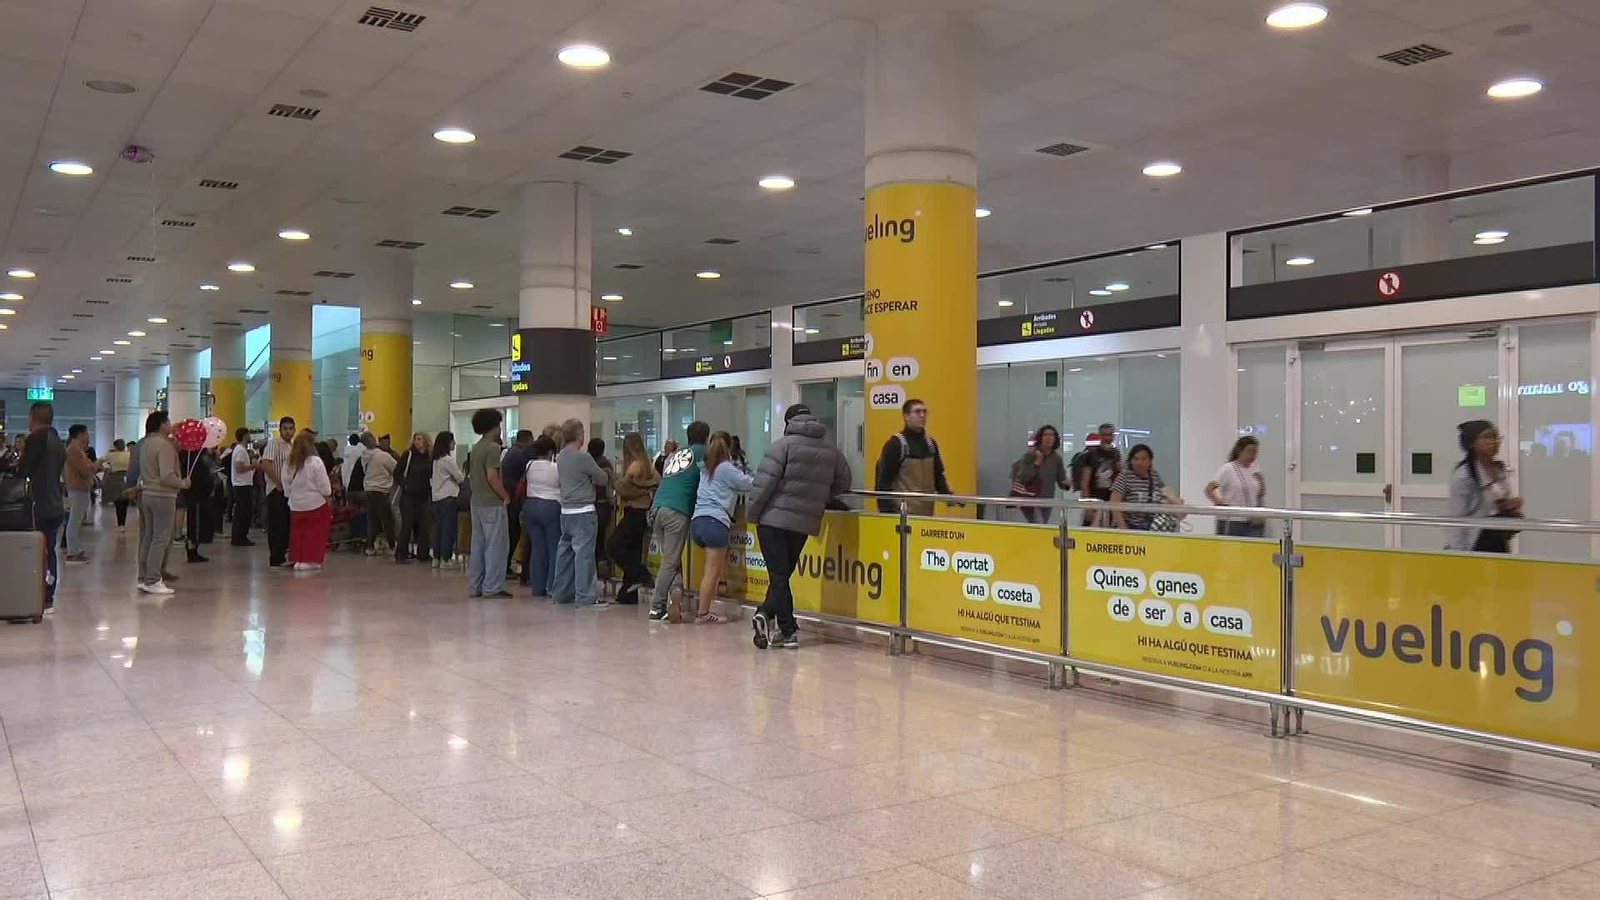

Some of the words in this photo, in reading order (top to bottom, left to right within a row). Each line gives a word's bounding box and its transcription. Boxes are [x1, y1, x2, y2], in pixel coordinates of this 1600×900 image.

[874, 300, 918, 313] ESPERAR
[867, 362, 879, 378] fin
[892, 364, 911, 376] en
[873, 392, 899, 405] casa
[921, 529, 949, 539] DARRERE
[949, 530, 965, 540] D'UN
[1086, 543, 1124, 555] DARRERE
[1125, 545, 1146, 556] D'UN
[798, 544, 883, 600] vueling
[926, 550, 946, 567] The
[956, 556, 989, 573] portat
[966, 583, 985, 597] una
[997, 588, 1033, 603] coseta
[1093, 568, 1139, 590] Quines
[1156, 579, 1198, 597] ganes
[957, 607, 965, 617] HI
[965, 609, 975, 619] HA
[975, 610, 994, 621] ALGÚ
[995, 613, 1010, 625] QUE
[1010, 615, 1041, 629] T'ESTIMA
[1112, 599, 1130, 617] de
[1145, 607, 1166, 621] ser
[1183, 612, 1192, 624] a
[1210, 615, 1243, 630] casa
[1137, 636, 1147, 647] HI
[1148, 637, 1162, 649] HA
[1163, 639, 1188, 652] ALGÚ
[1189, 642, 1209, 656] QUE
[1210, 645, 1253, 661] T'ESTIMA
[1320, 604, 1554, 702] vueling
